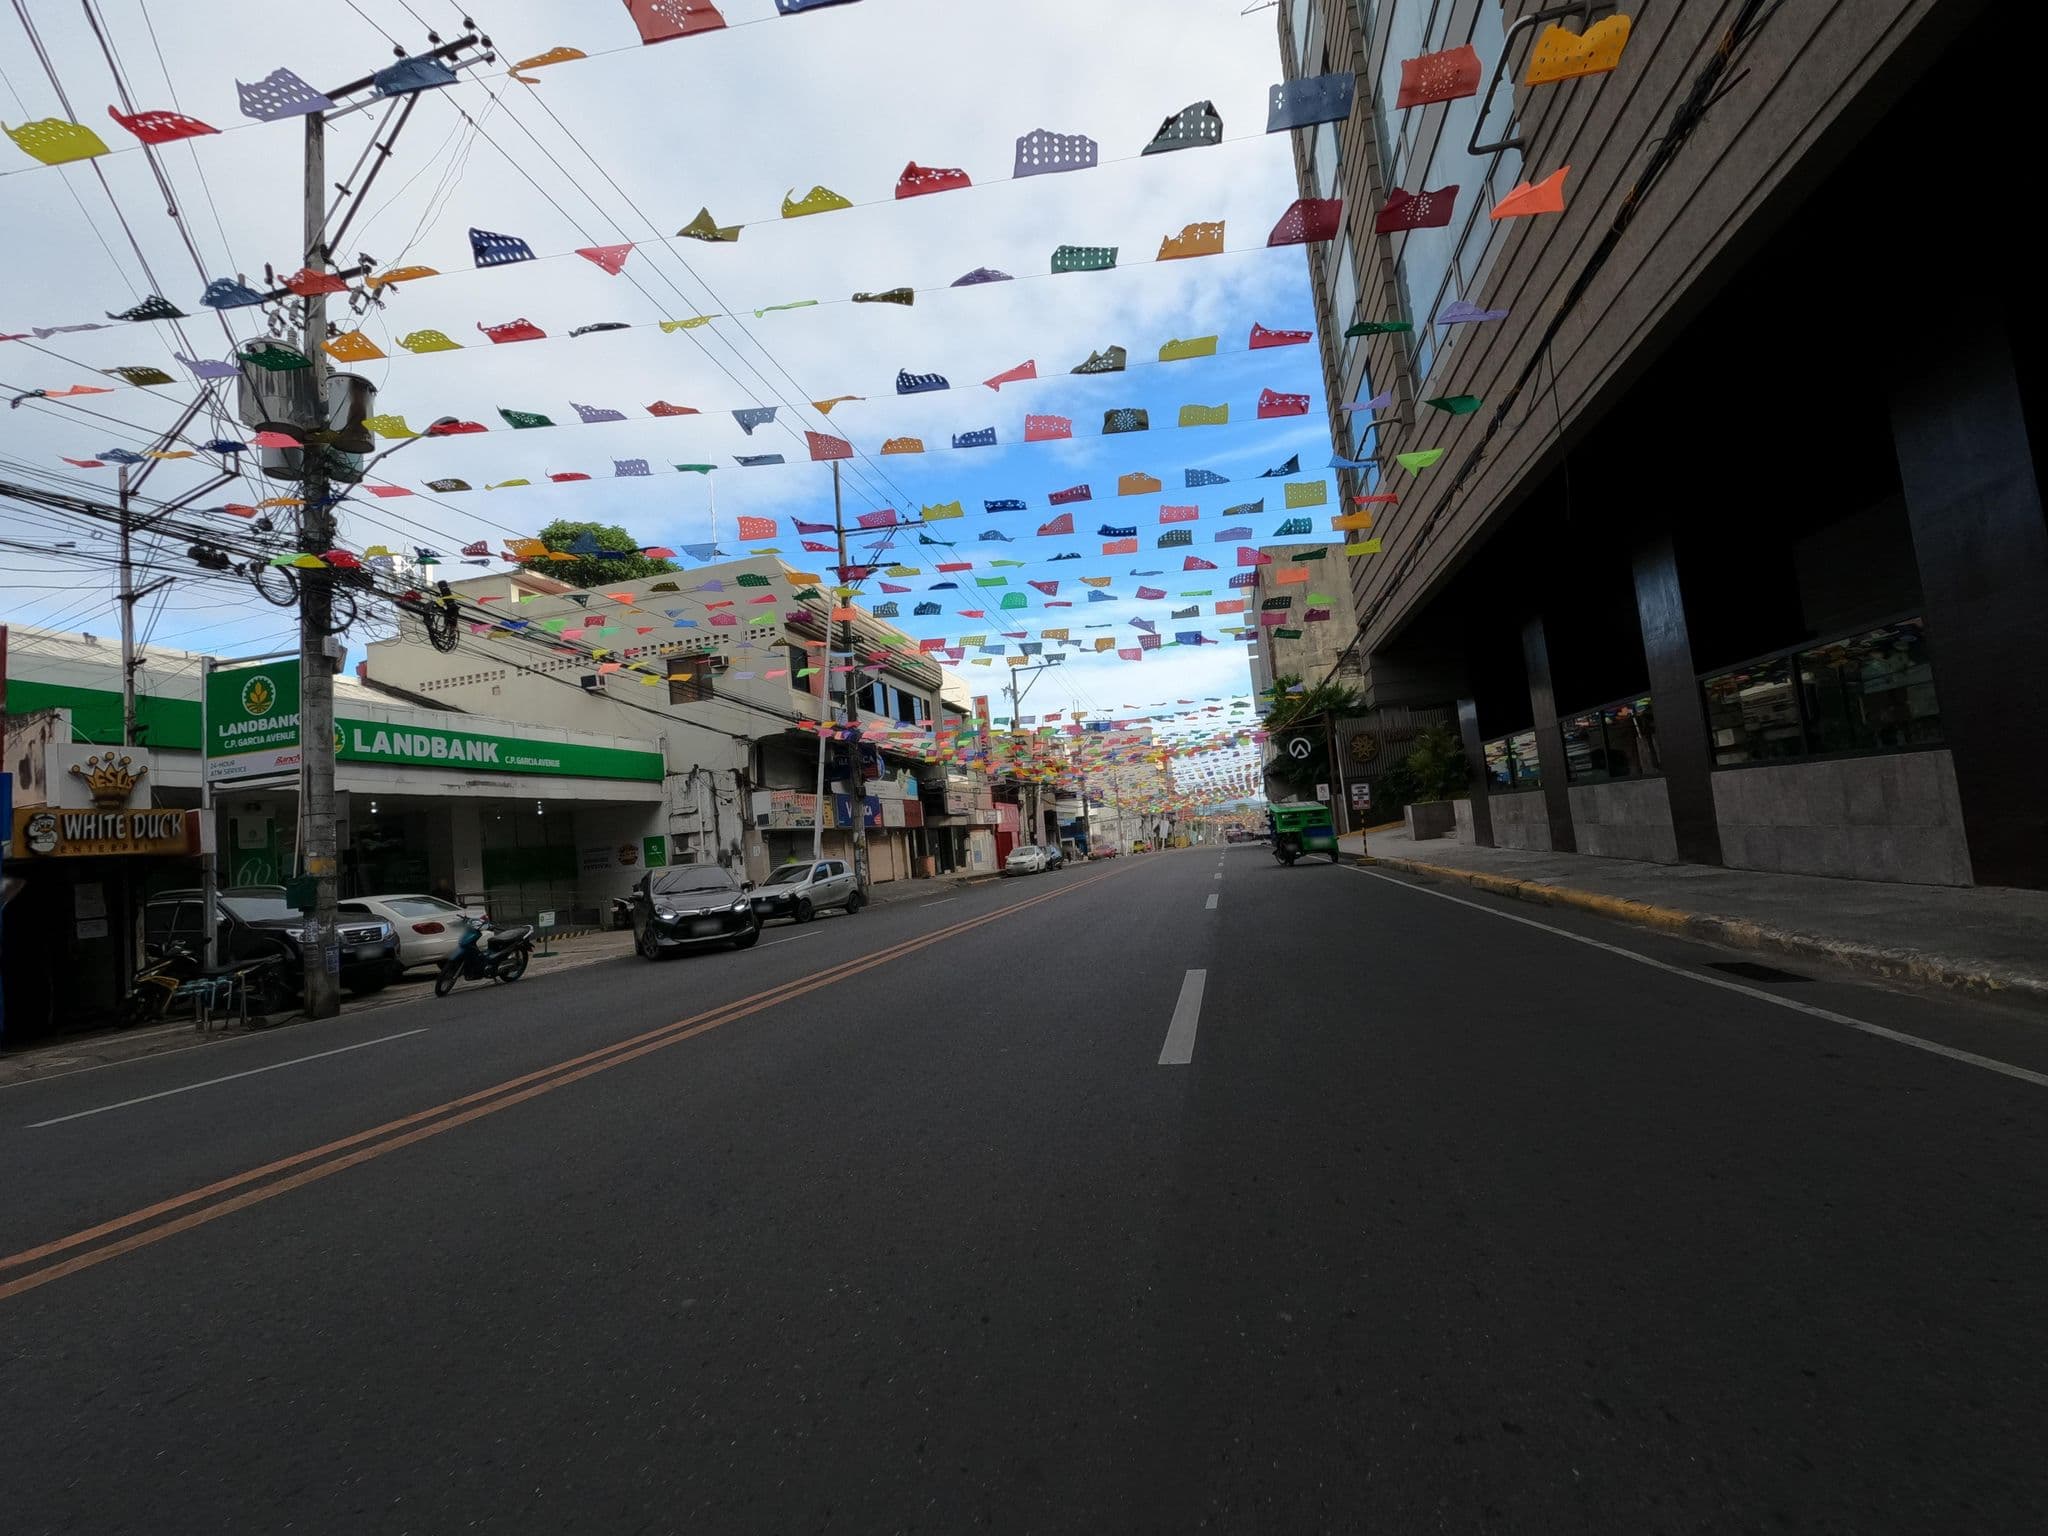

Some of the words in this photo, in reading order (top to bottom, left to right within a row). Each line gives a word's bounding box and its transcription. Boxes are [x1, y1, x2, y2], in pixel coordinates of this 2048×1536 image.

[219, 713, 302, 737] LANDBANK
[239, 736, 265, 747] GARCIA
[266, 730, 296, 743] AVENUE
[353, 728, 499, 763] LANDBANK
[64, 813, 127, 840] WHITE
[134, 812, 183, 840] DUCK
